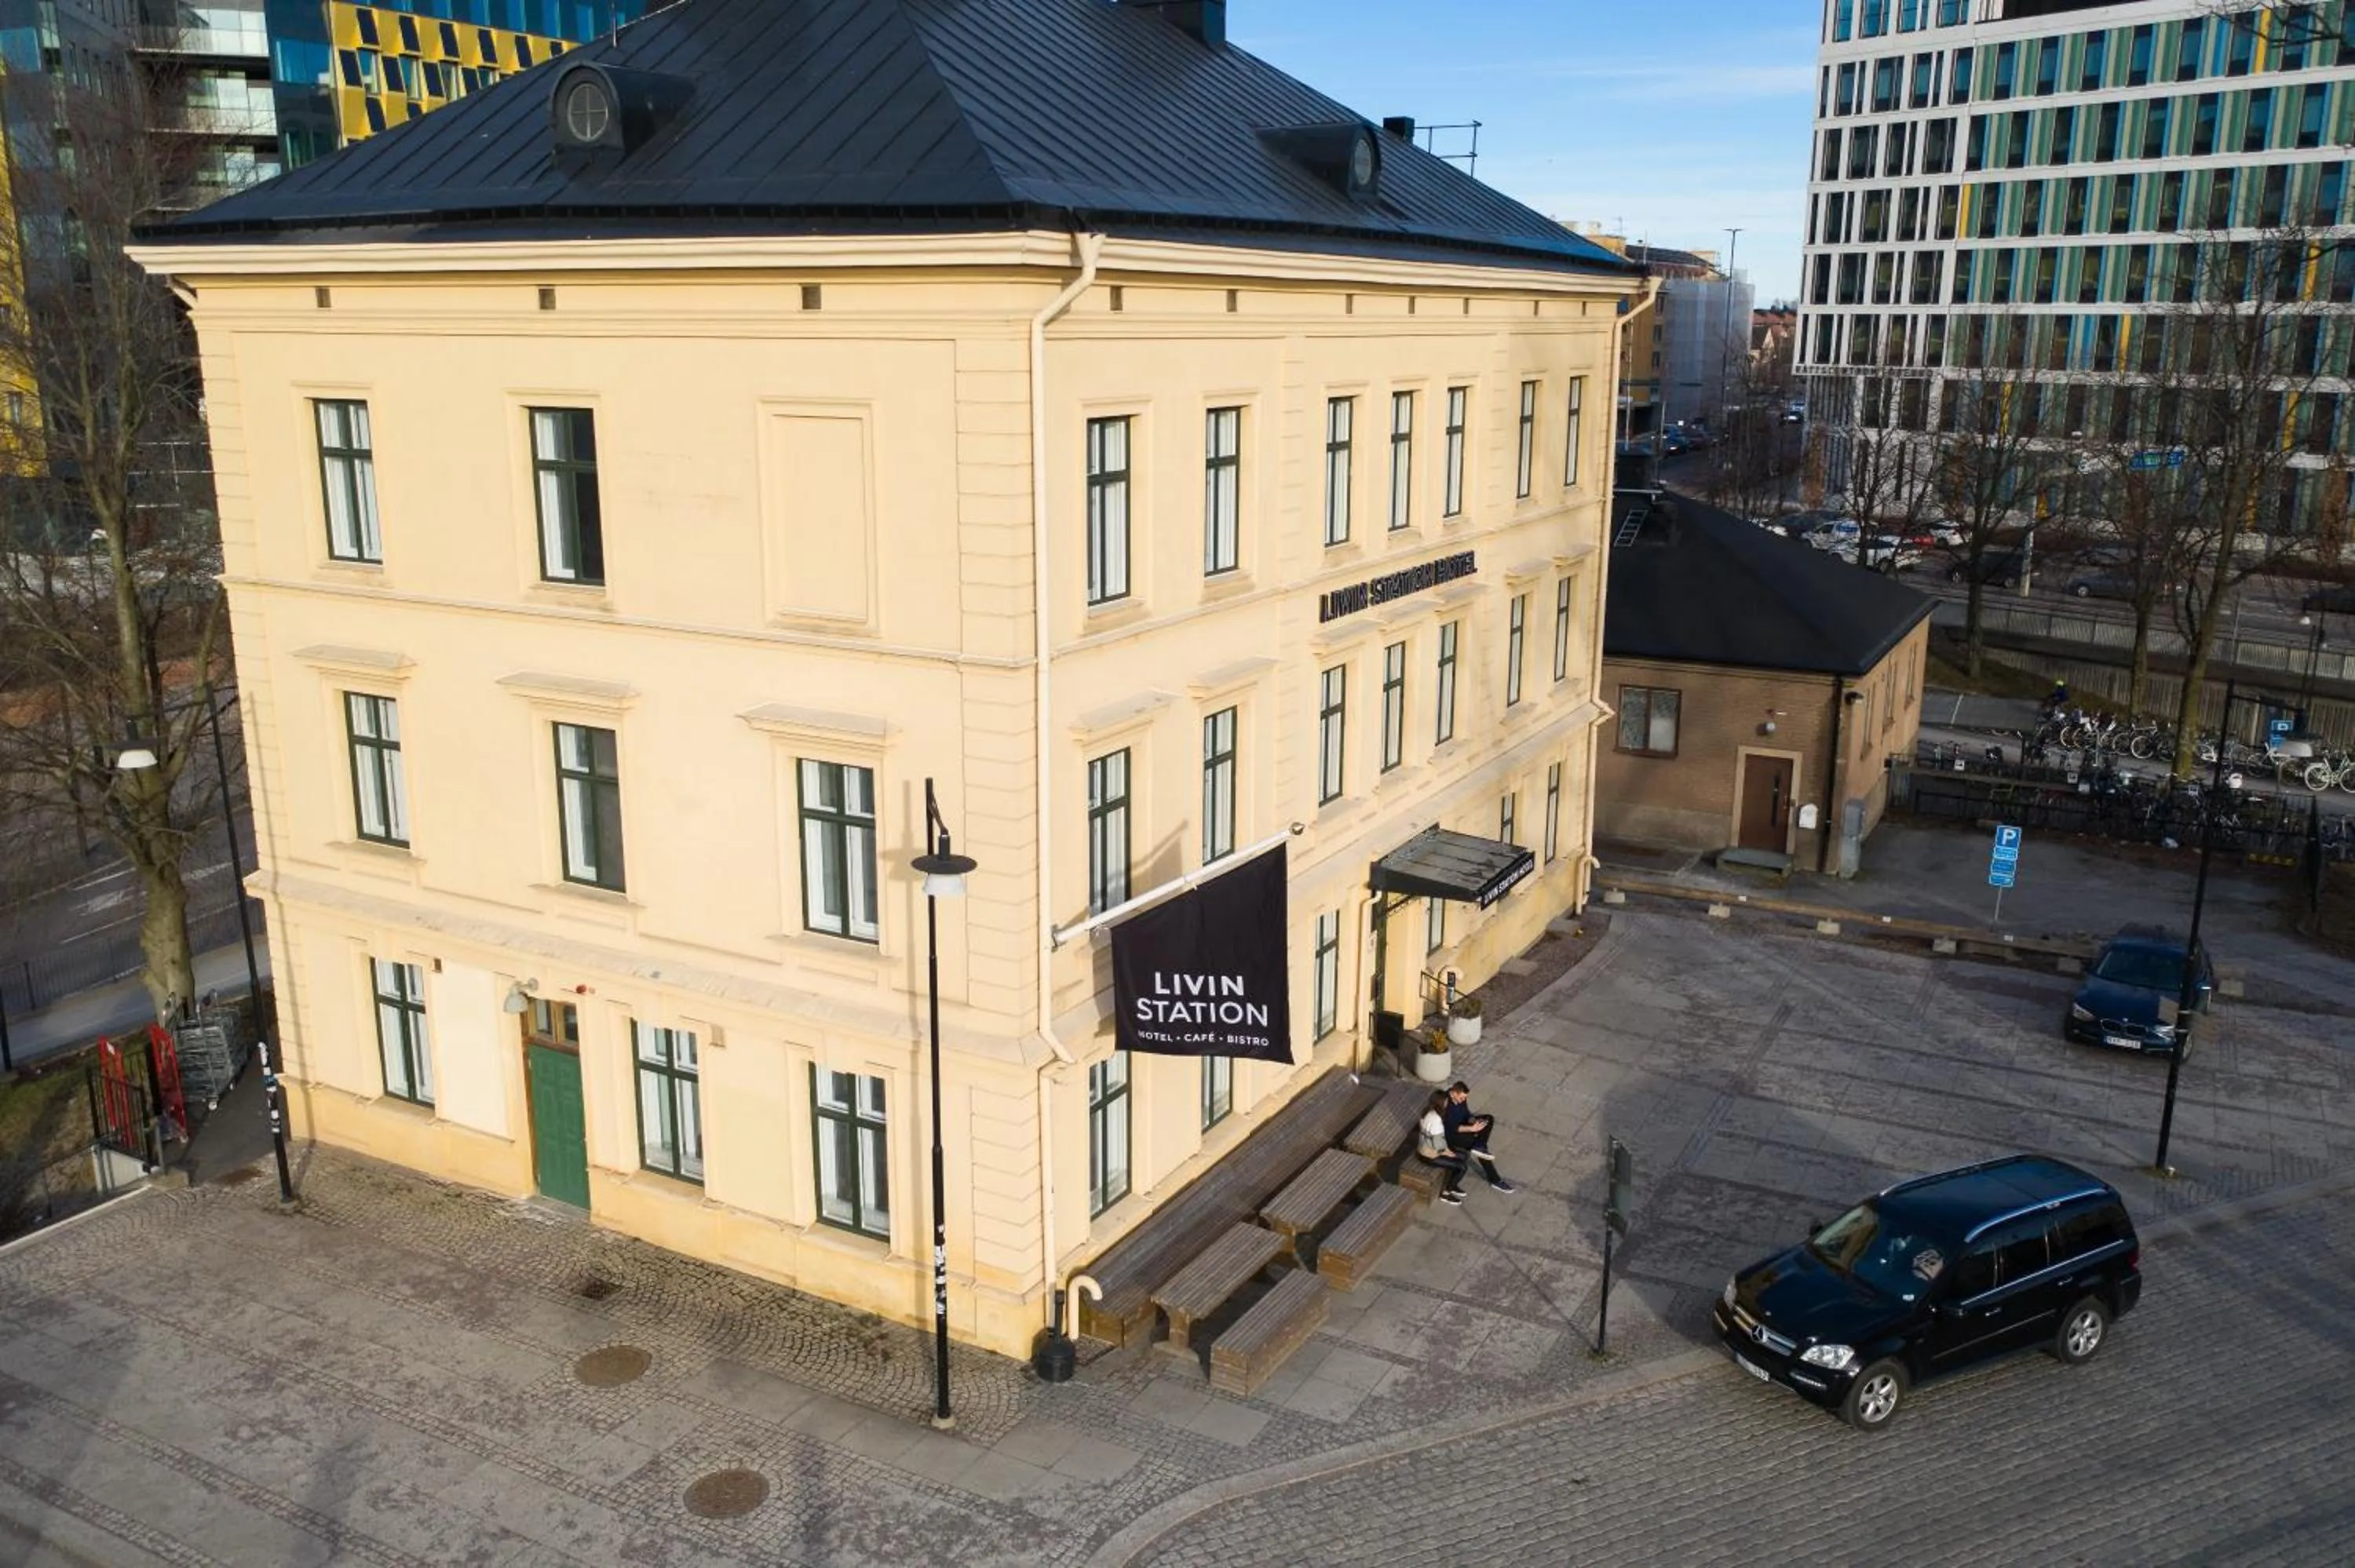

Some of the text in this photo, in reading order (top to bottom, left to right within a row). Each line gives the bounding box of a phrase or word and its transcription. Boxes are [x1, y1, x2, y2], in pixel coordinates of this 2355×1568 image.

[1319, 549, 1477, 623] LIVIN STATION HOTEL
[2002, 829, 2017, 845] P
[1155, 972, 1244, 996] LIVIN
[1137, 997, 1268, 1026] STATION
[1138, 1030, 1269, 1046] HOTEL CAFÉ BISTRO
